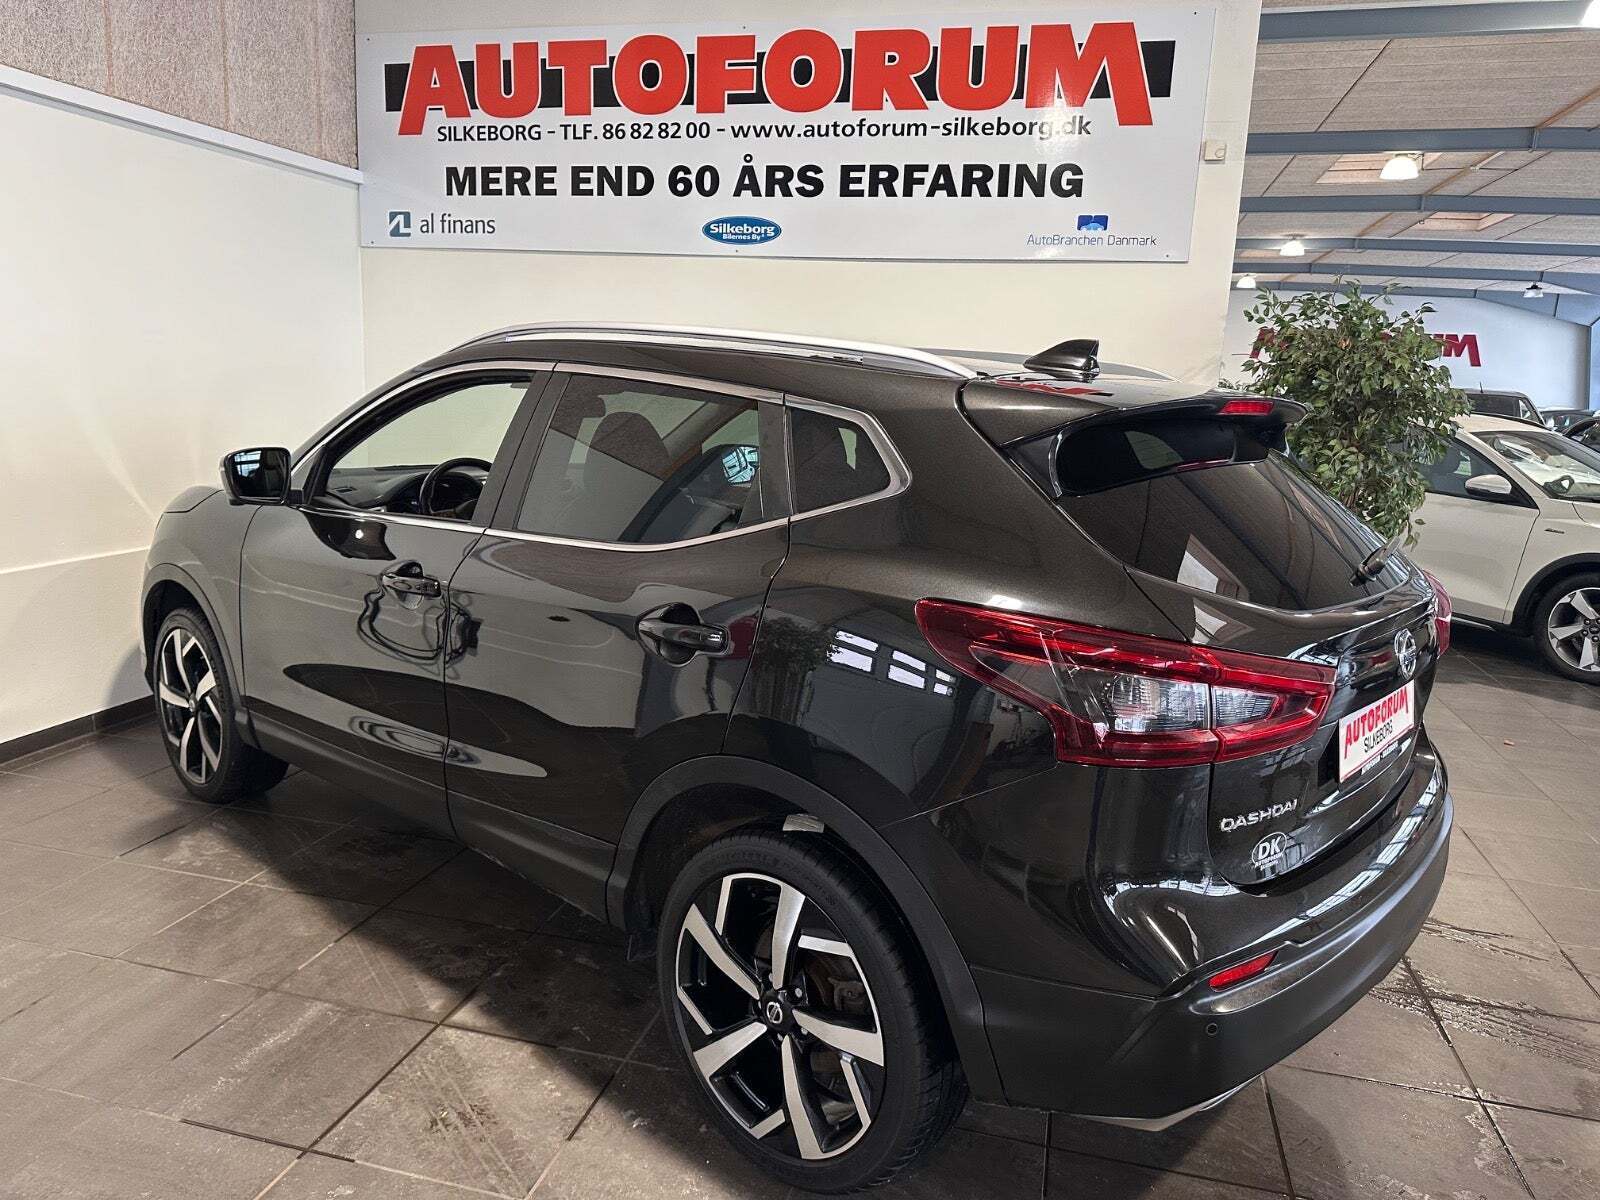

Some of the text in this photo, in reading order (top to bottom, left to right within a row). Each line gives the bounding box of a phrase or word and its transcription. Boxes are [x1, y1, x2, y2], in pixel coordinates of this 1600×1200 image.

[398, 22, 1154, 136] AUTOFORUM
[437, 124, 542, 142] SILKEBORG
[560, 123, 598, 140] TLF.
[602, 122, 626, 140] 86
[630, 122, 654, 139] 82
[658, 122, 682, 139] 82
[685, 121, 711, 139] 00
[730, 117, 1092, 141] www.autoforum-silkeborg.dk
[445, 153, 1084, 199] MERE END 60 ÅRS ERFARING
[420, 212, 496, 234] al finans
[709, 223, 776, 237] Silkeborg
[1027, 234, 1157, 246] AutoBranchen Danmark
[1344, 686, 1409, 760] AUTOFORUM
[1258, 836, 1282, 860] DK
